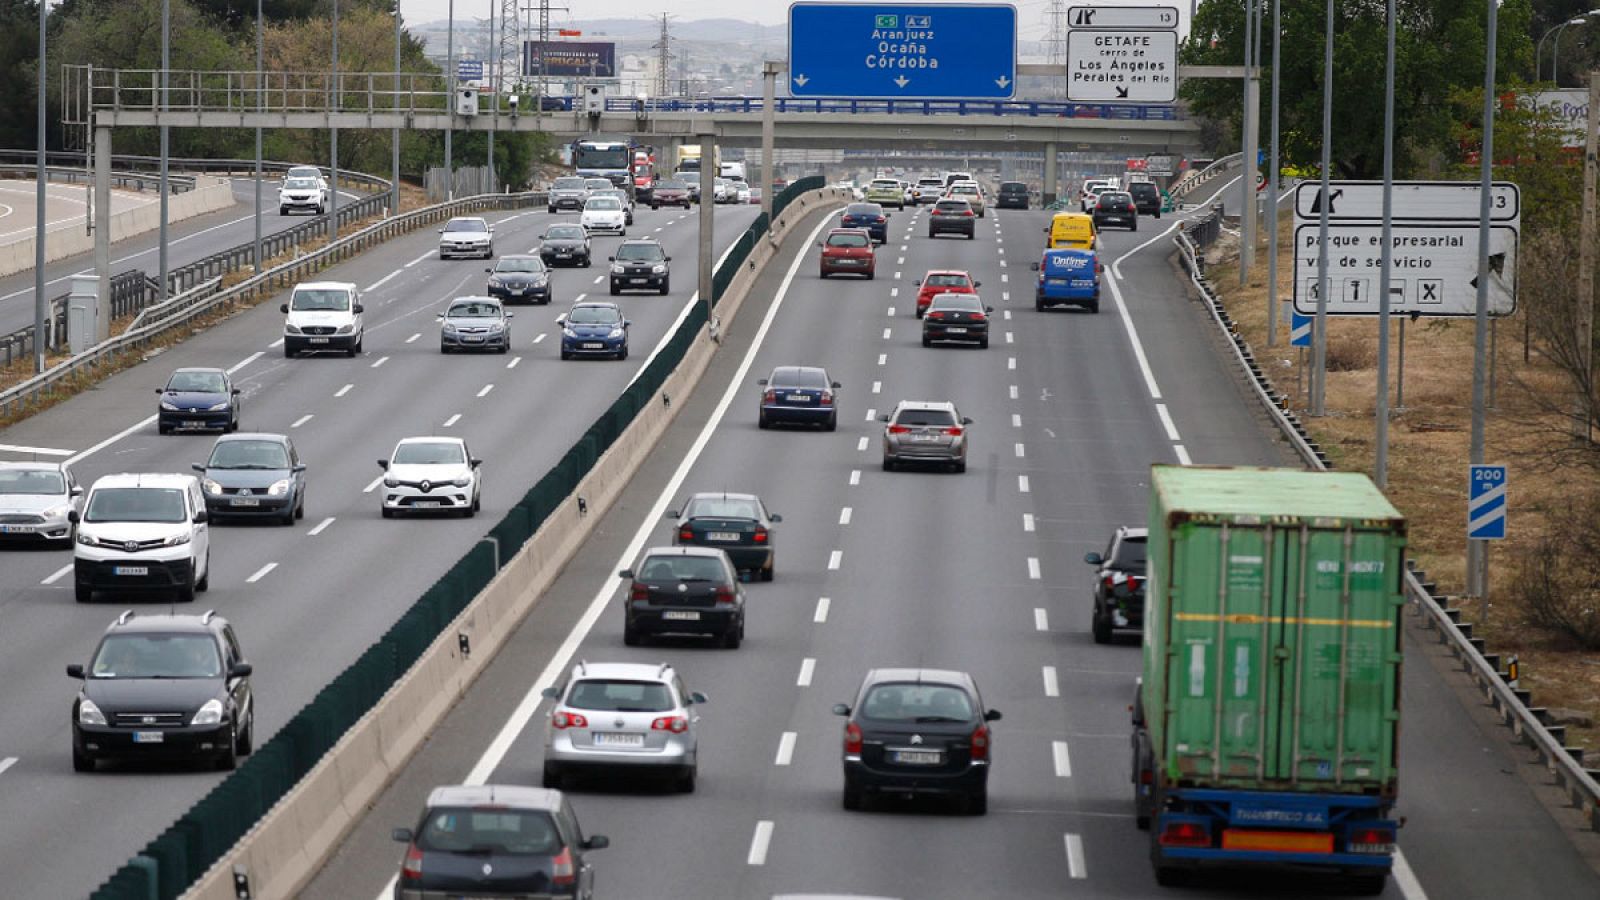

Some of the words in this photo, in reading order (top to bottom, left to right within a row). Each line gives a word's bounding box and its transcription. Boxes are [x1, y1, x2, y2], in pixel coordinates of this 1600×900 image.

[907, 16, 929, 26] A-4
[1160, 13, 1171, 22] 13
[871, 28, 934, 42] Aranjuez
[1094, 36, 1151, 46] GETAFE
[878, 41, 926, 54] Ocaña
[1099, 49, 1128, 57] cerro
[1133, 48, 1145, 57] de
[865, 54, 939, 69] Córdoba
[1079, 60, 1102, 70] Los
[1110, 57, 1165, 72] Ángeles
[1074, 72, 1124, 82] Perales
[1130, 74, 1146, 83] del
[1369, 235, 1464, 249] epresarial
[1339, 255, 1357, 267] de
[1366, 255, 1432, 268] sevicio
[1475, 469, 1502, 481] 200
